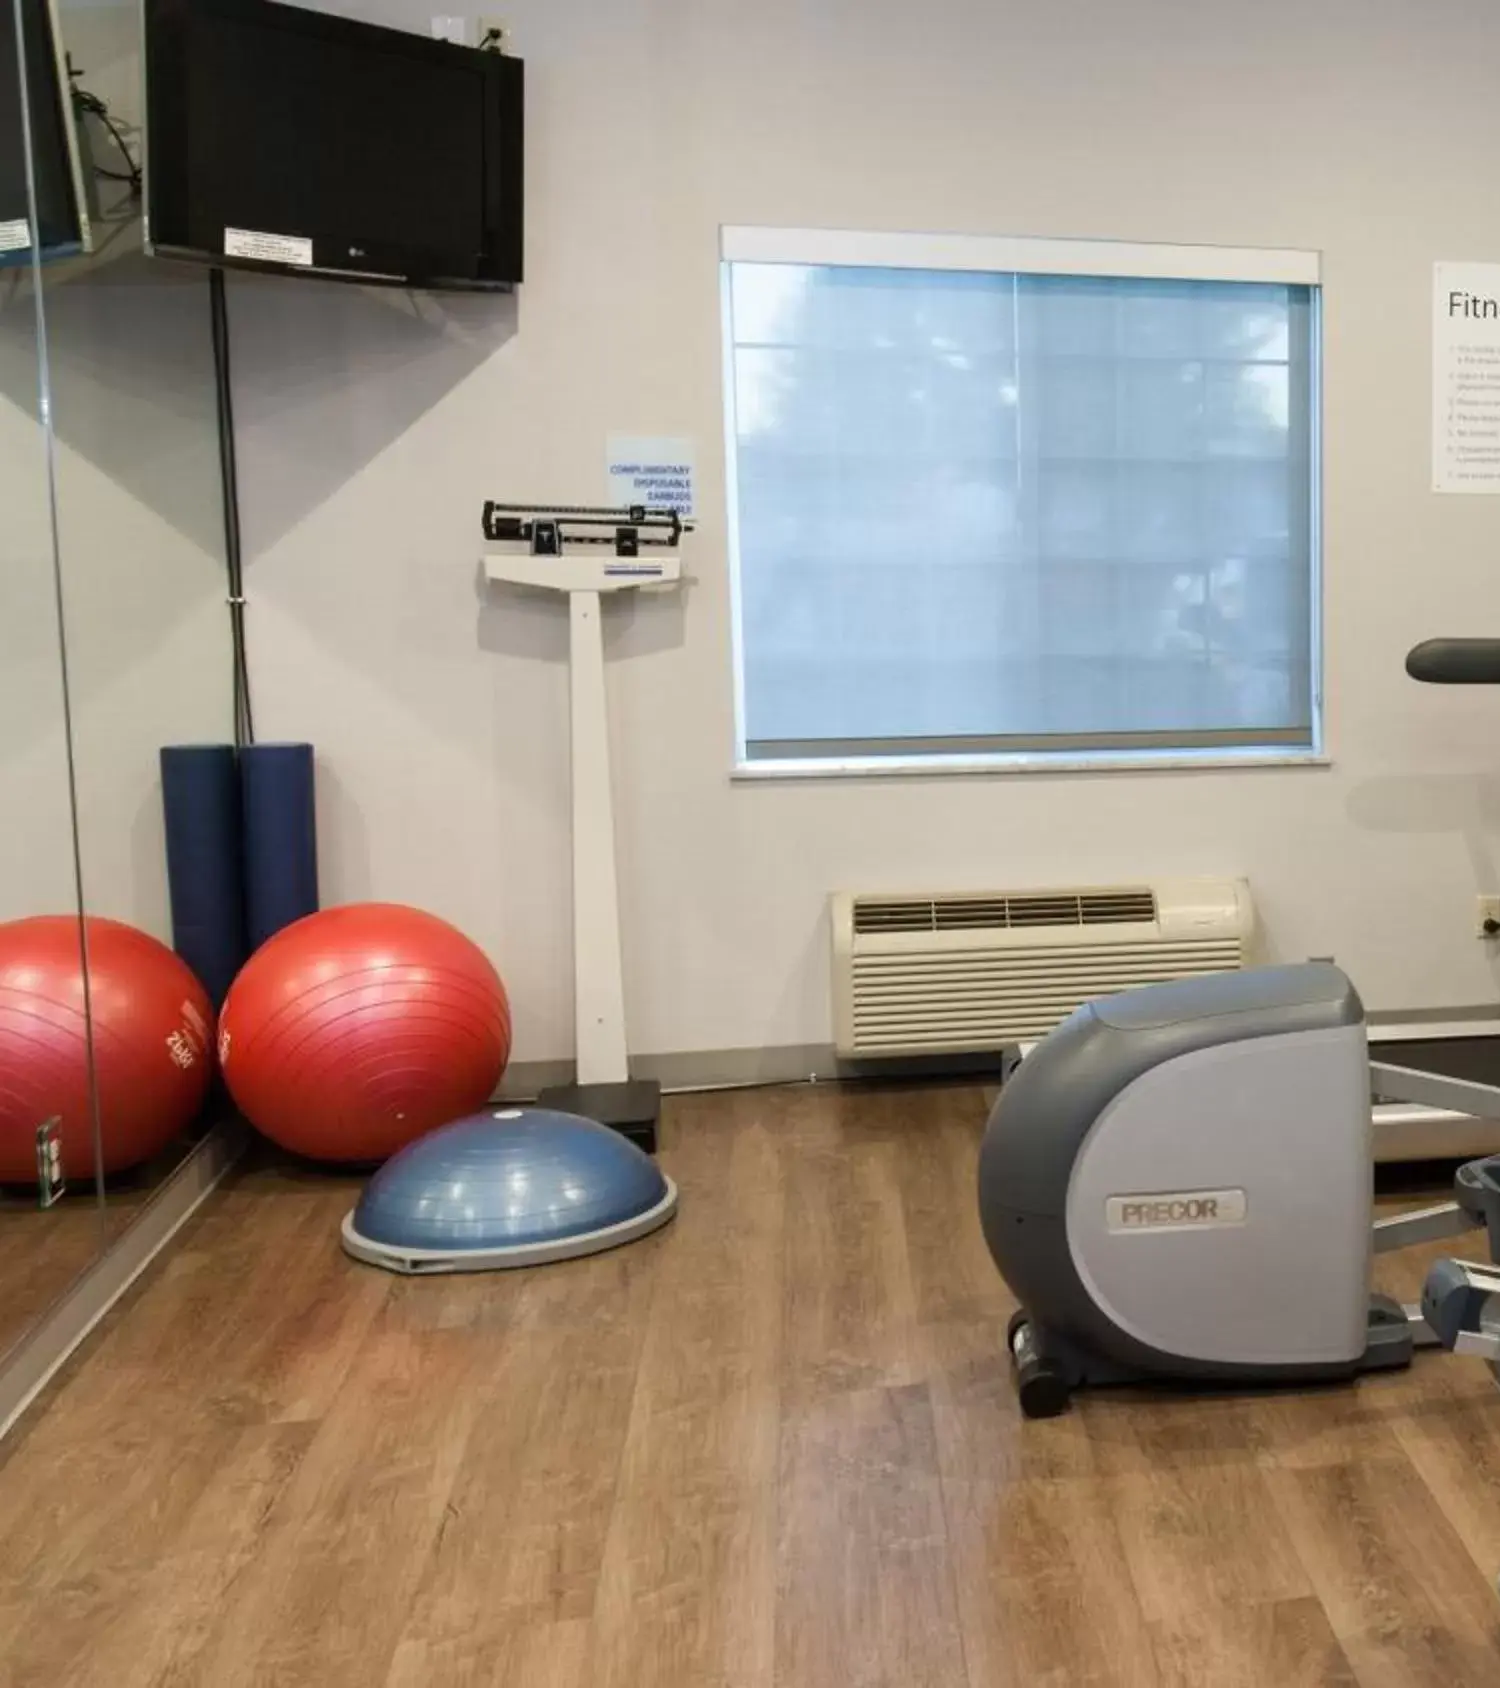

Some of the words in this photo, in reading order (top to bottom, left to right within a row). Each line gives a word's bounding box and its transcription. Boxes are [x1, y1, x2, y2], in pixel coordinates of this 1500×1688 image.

[610, 464, 691, 475] COMPLIMENTARY
[634, 478, 691, 489] DISPOSABLE
[1122, 1199, 1218, 1224] PRECOR
